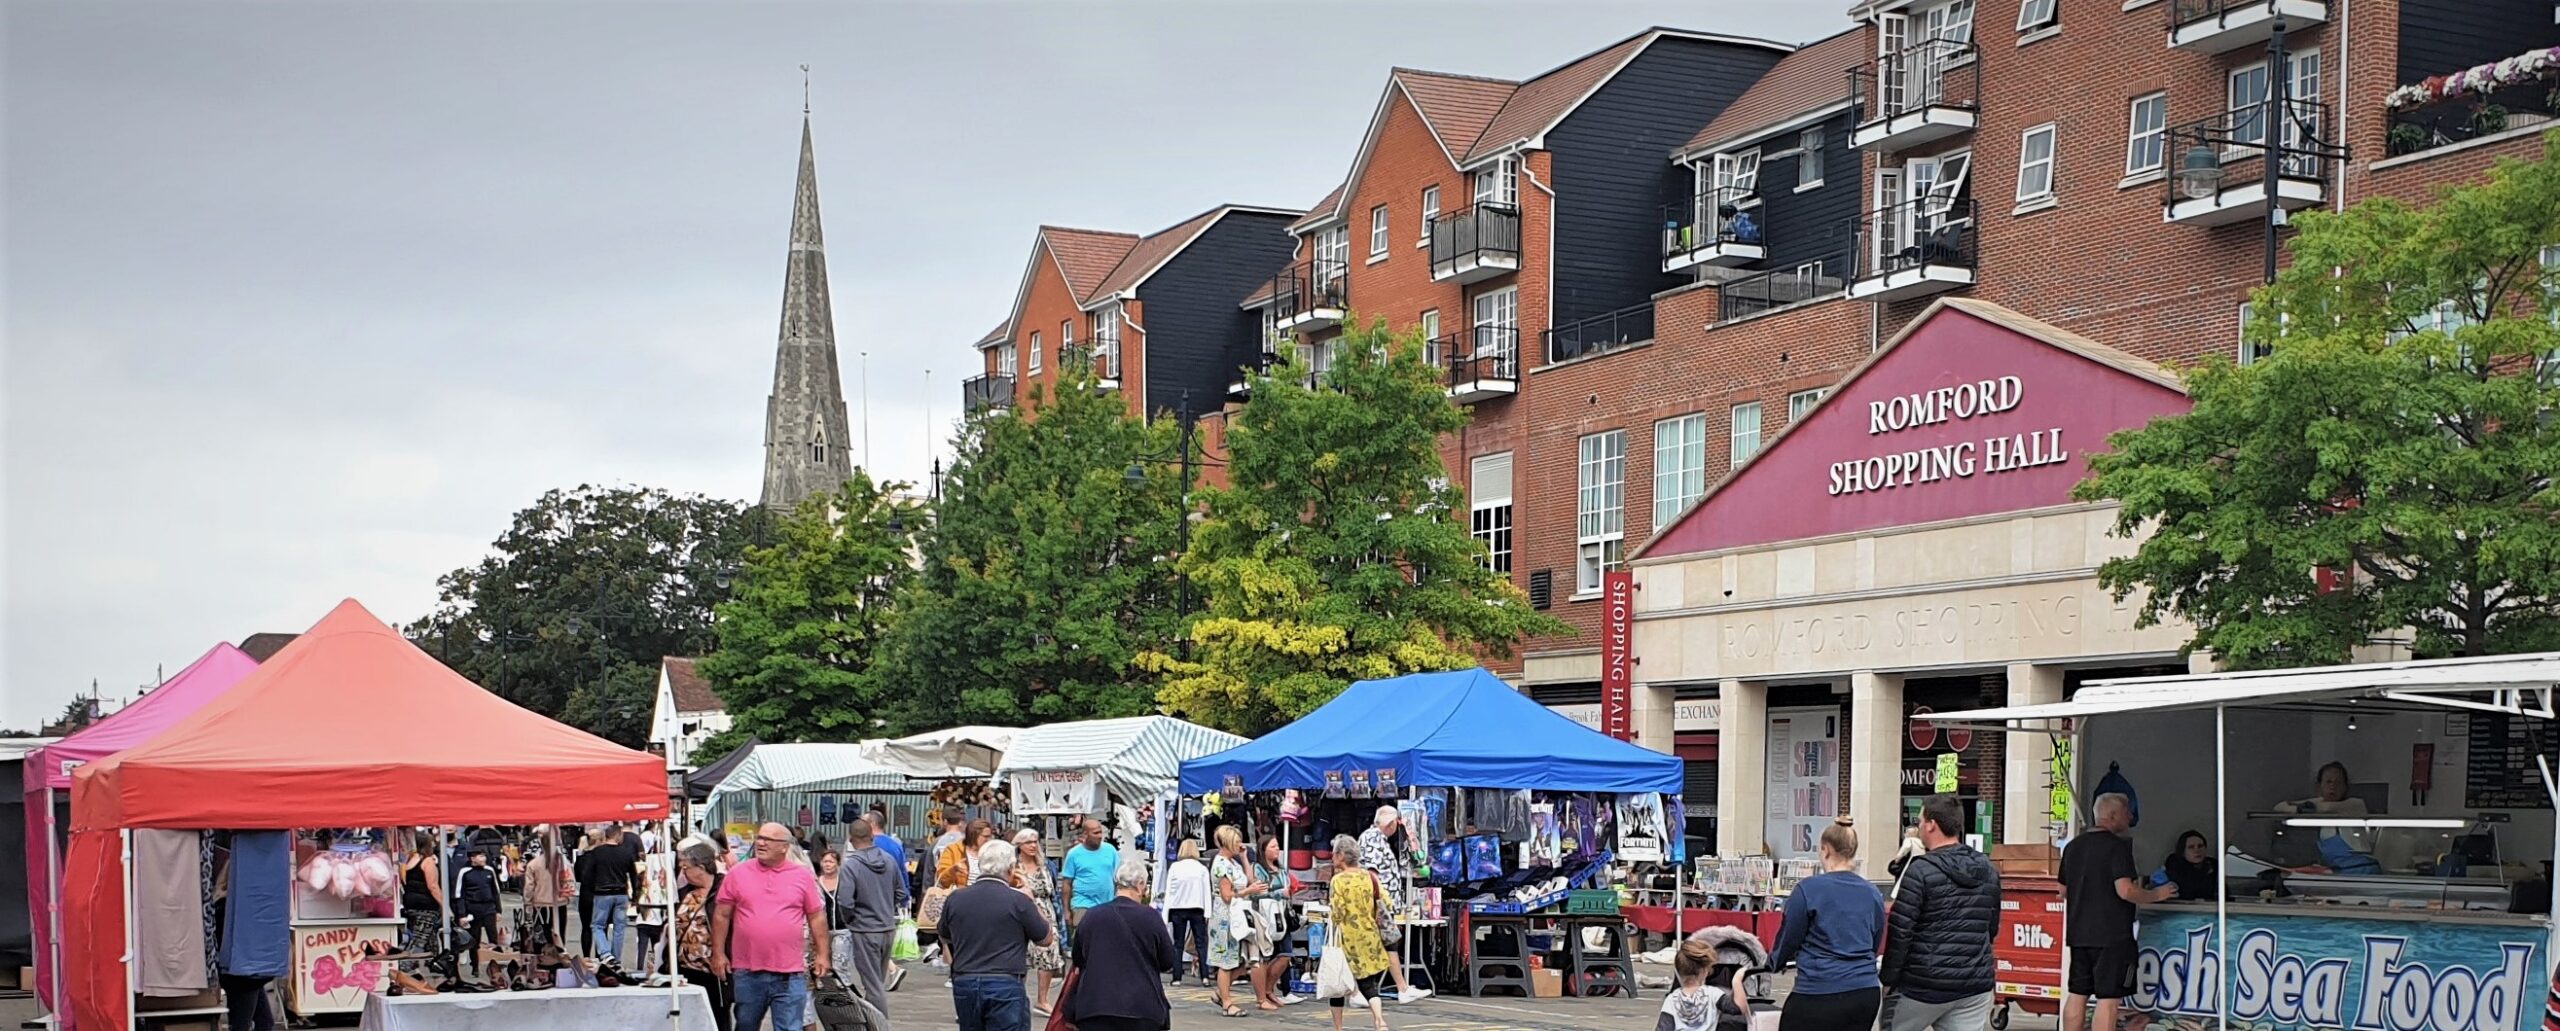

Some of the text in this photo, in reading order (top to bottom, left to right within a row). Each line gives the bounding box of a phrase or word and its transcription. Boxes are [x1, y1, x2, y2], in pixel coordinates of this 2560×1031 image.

[1868, 374, 2024, 435] ROMFORD
[1828, 427, 2069, 496] SHOPPING HALL
[1610, 580, 1626, 738] SHOPPING HALL
[1722, 613, 1873, 660] ROMFORD
[1794, 740, 1837, 777] SHOP
[1794, 781, 1833, 817] with
[305, 927, 358, 947] CANDY
[2127, 923, 2537, 1031] esh Sea Food
